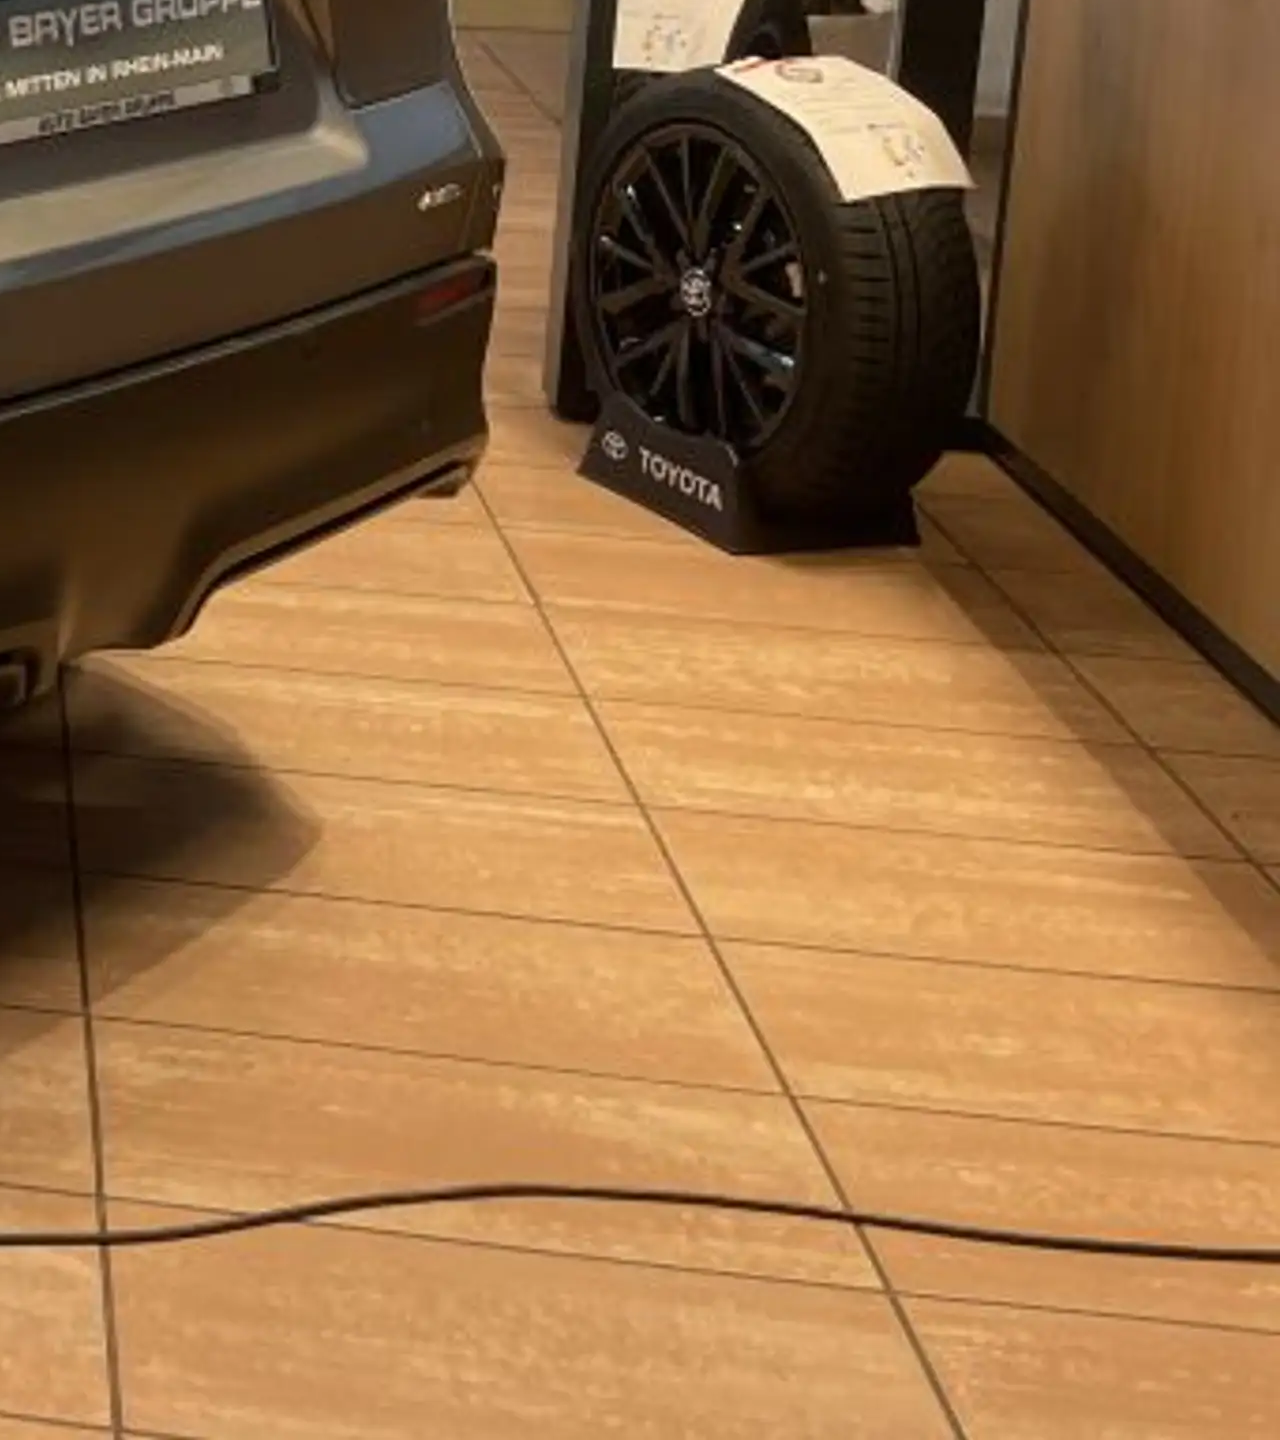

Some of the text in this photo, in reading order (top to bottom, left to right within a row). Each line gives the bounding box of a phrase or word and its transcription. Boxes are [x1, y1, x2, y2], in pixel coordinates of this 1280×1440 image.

[5, 70, 80, 100] MITTEN
[85, 63, 106, 85] IN
[112, 43, 224, 80] RHEIN-MAIN
[639, 445, 723, 511] TOYOTA
